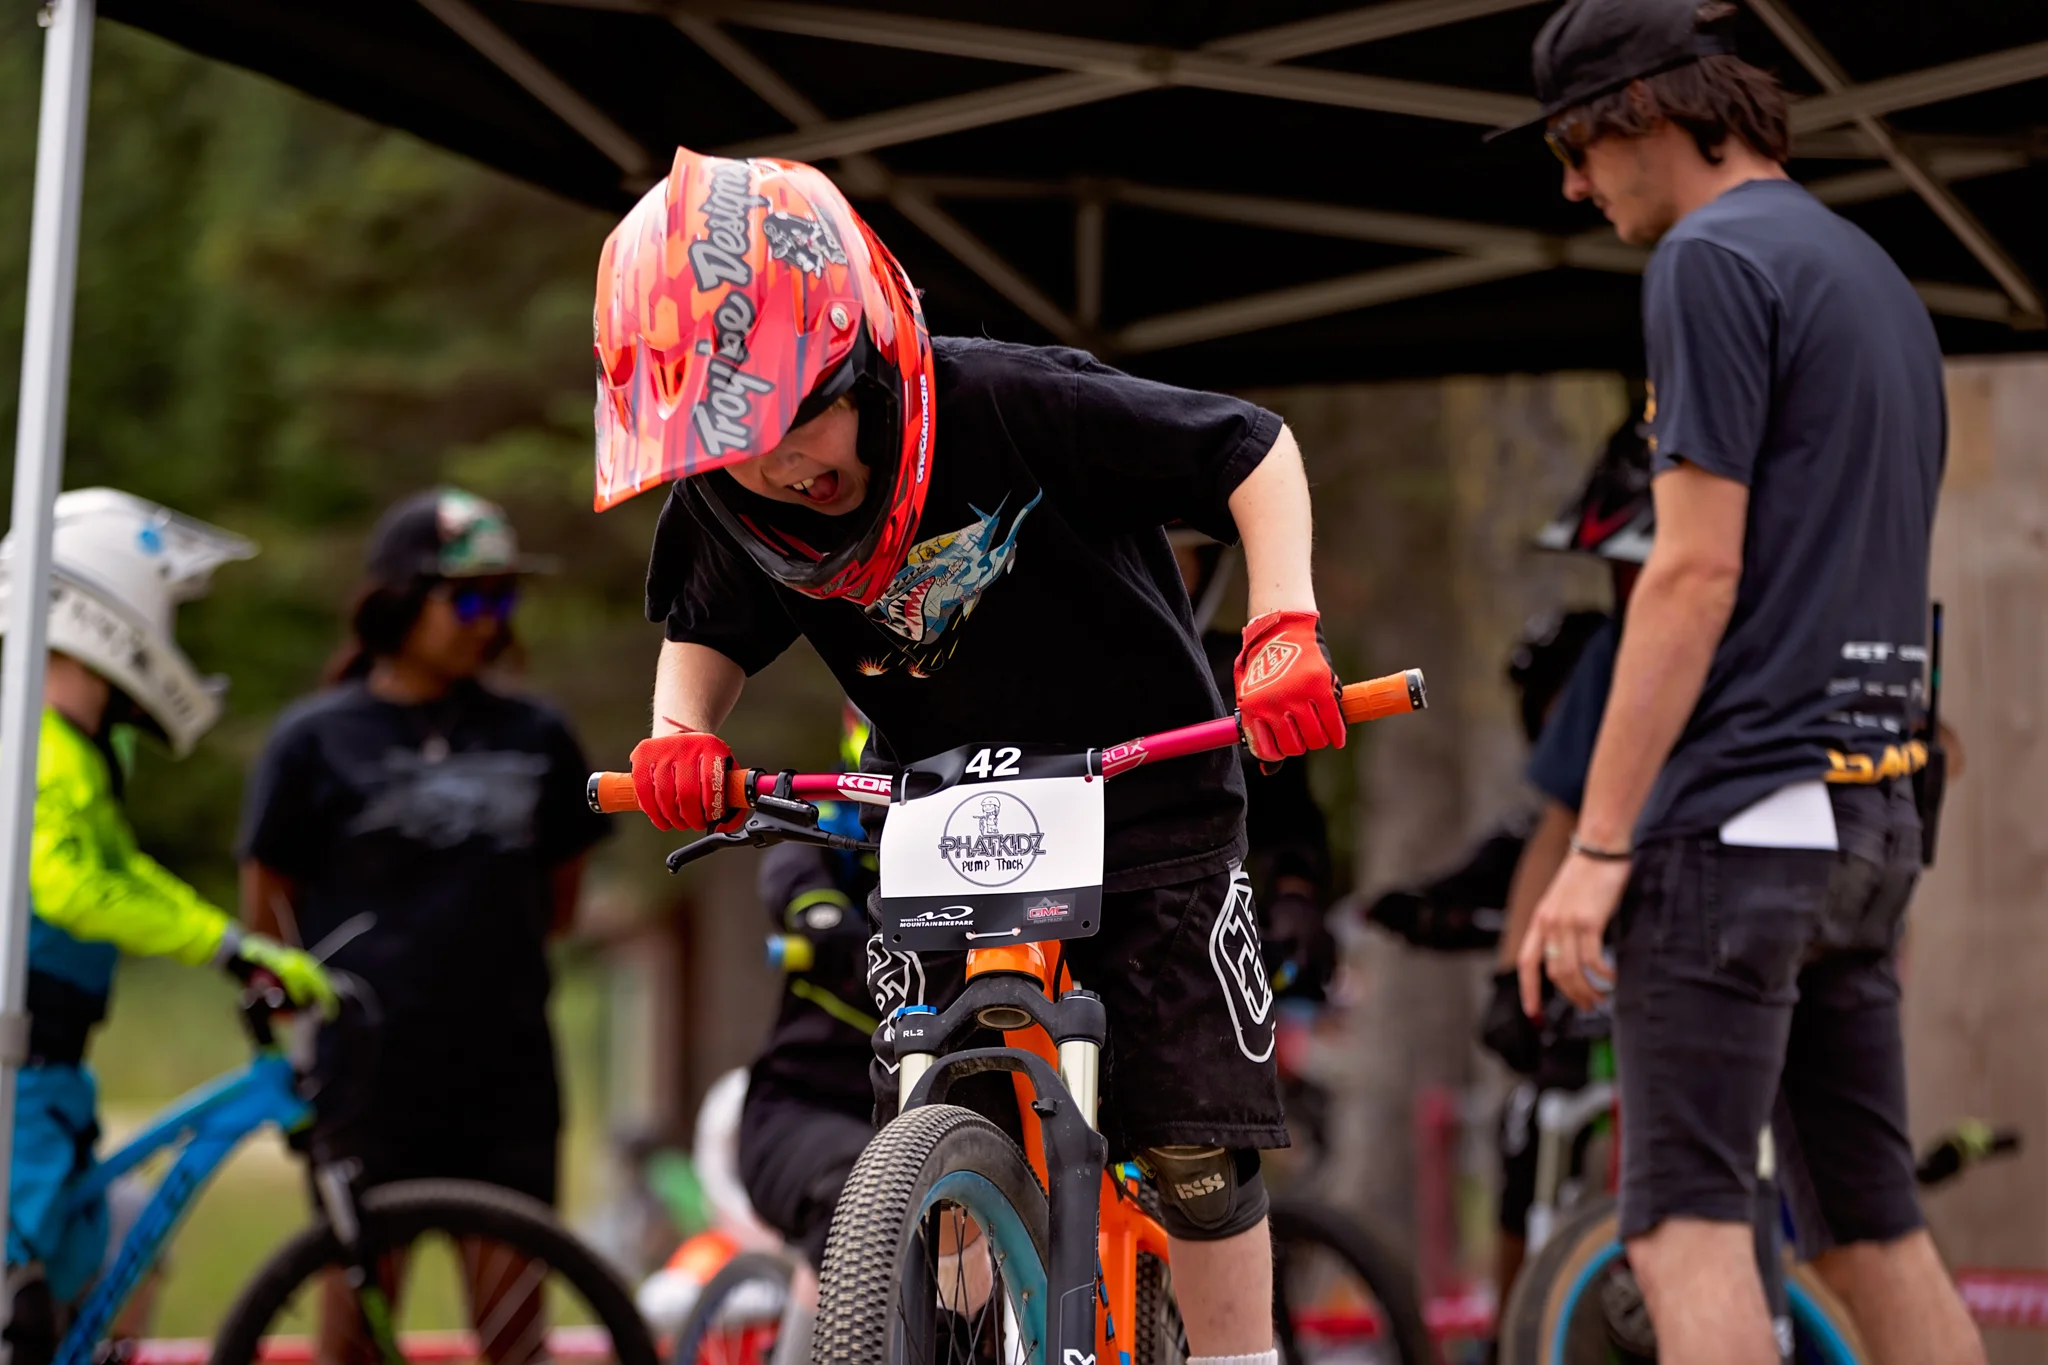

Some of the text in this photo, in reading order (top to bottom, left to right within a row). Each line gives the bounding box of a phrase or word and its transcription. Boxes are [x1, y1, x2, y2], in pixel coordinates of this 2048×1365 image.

[693, 359, 775, 457] Troy
[965, 747, 1021, 778] 42
[938, 833, 1046, 859] PHATKIDZ
[1029, 905, 1068, 918] GMC
